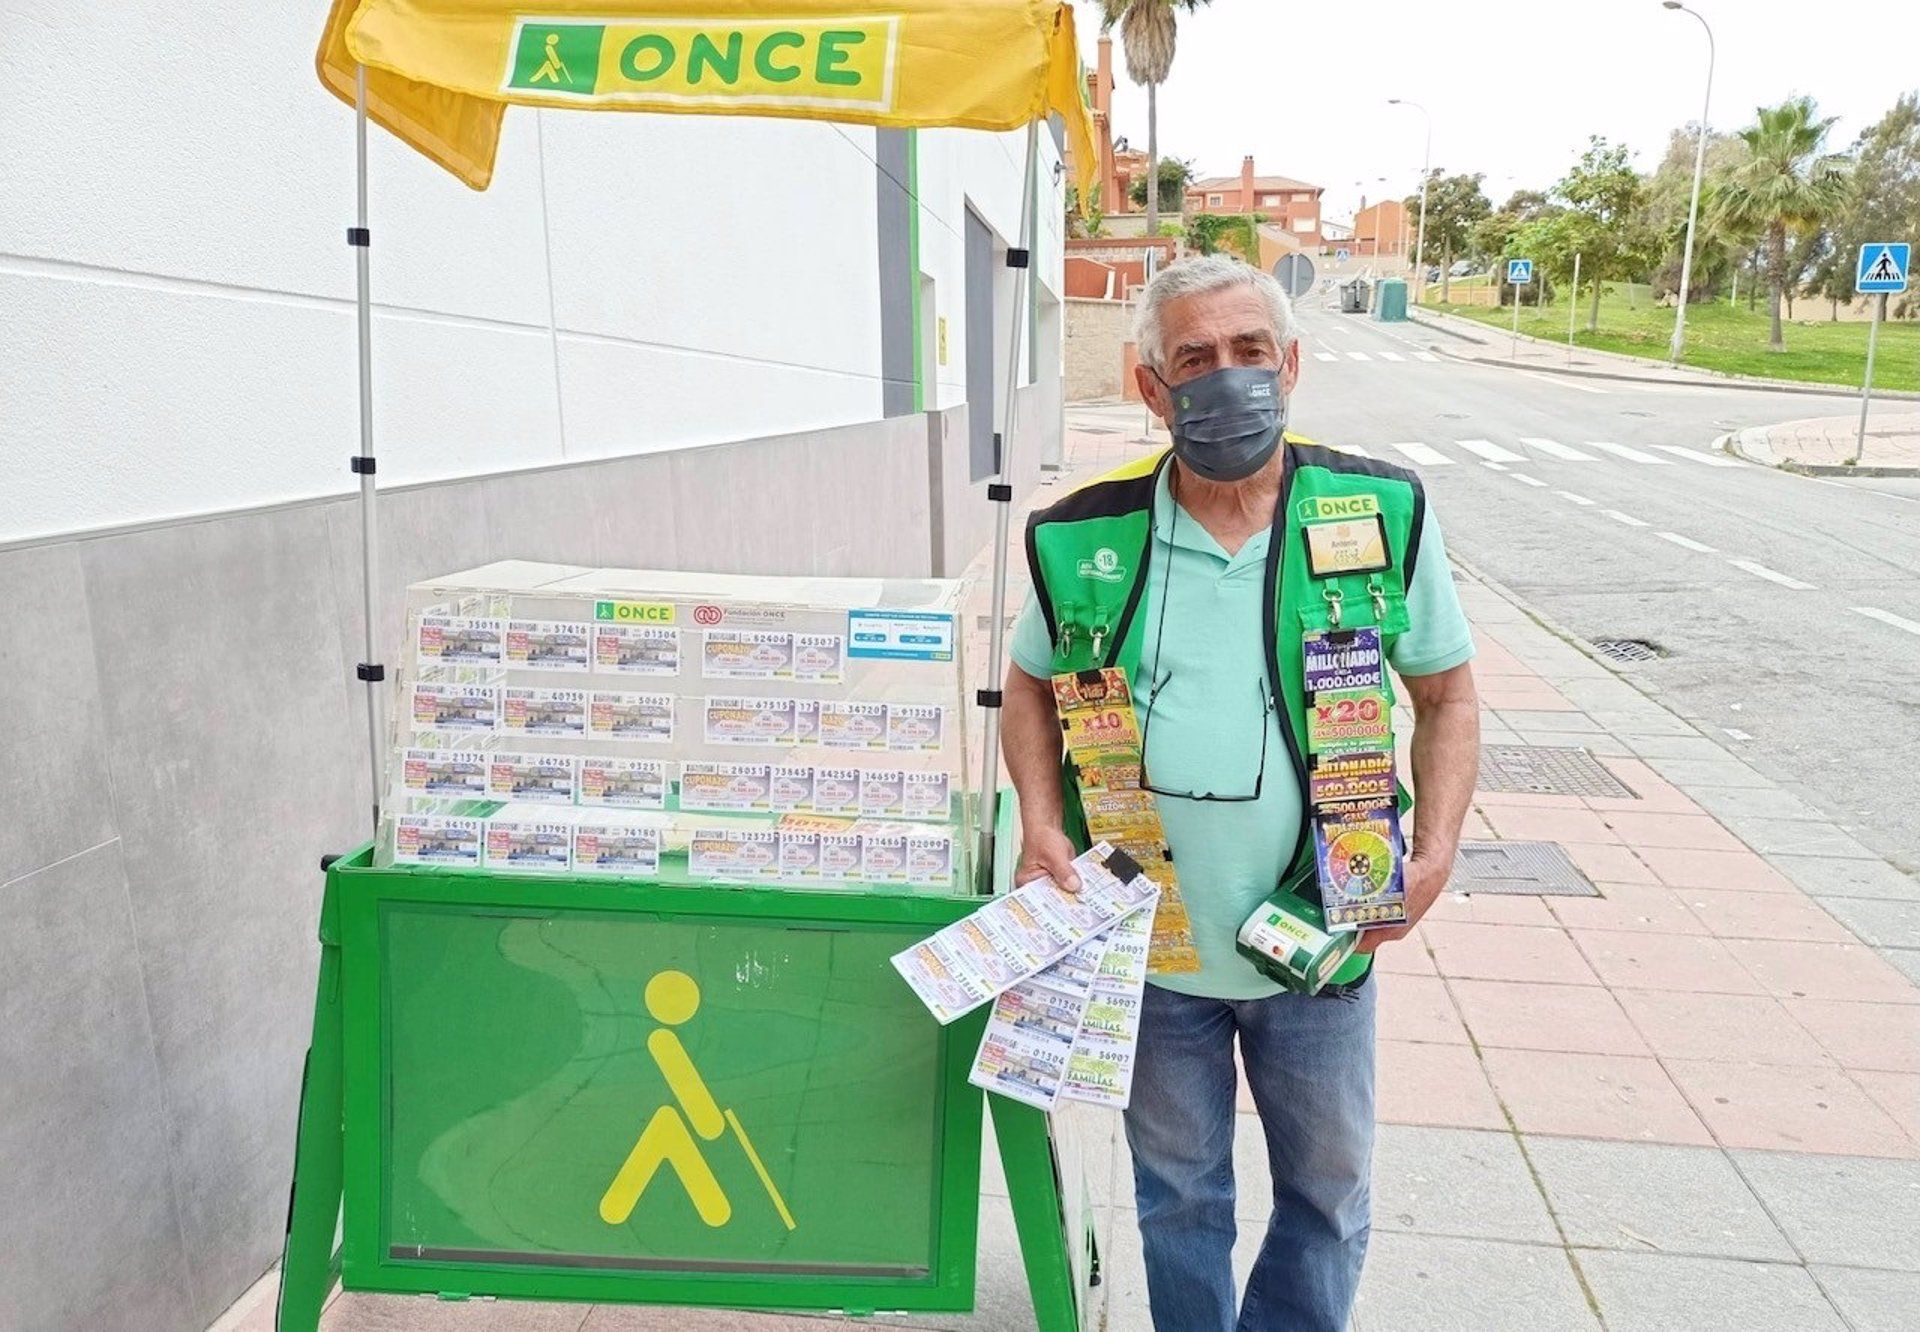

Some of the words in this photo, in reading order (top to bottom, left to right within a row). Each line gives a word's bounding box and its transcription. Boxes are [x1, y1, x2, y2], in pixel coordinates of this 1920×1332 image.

[619, 31, 867, 88] ONCE
[1321, 498, 1375, 515] ONCE
[618, 606, 671, 621] ONCE
[1307, 672, 1381, 690] 1.000.000€
[1279, 921, 1310, 940] ONCE
